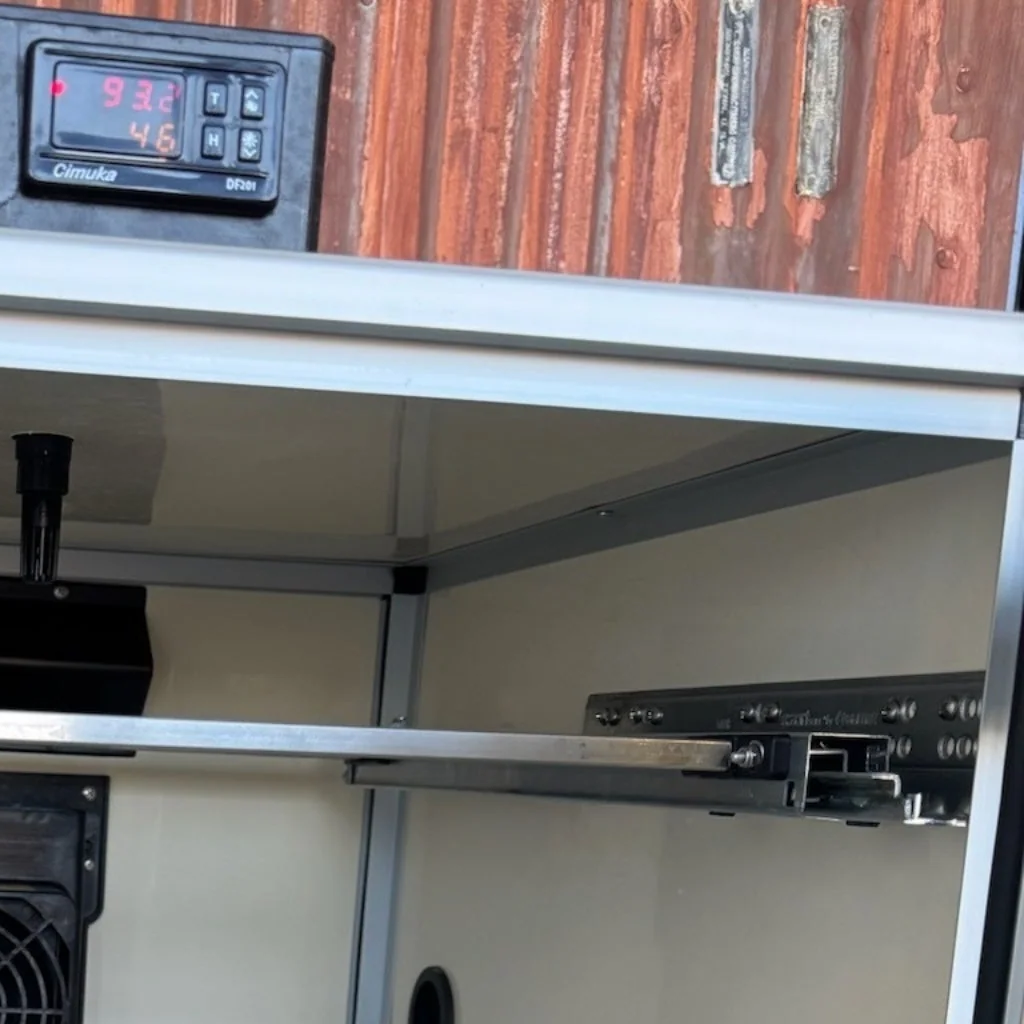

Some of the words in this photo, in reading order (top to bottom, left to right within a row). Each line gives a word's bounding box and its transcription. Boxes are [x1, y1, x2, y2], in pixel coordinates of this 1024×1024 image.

[209, 92, 221, 105] T
[129, 121, 176, 153] 46
[208, 134, 219, 147] H
[53, 163, 118, 183] Cimuka
